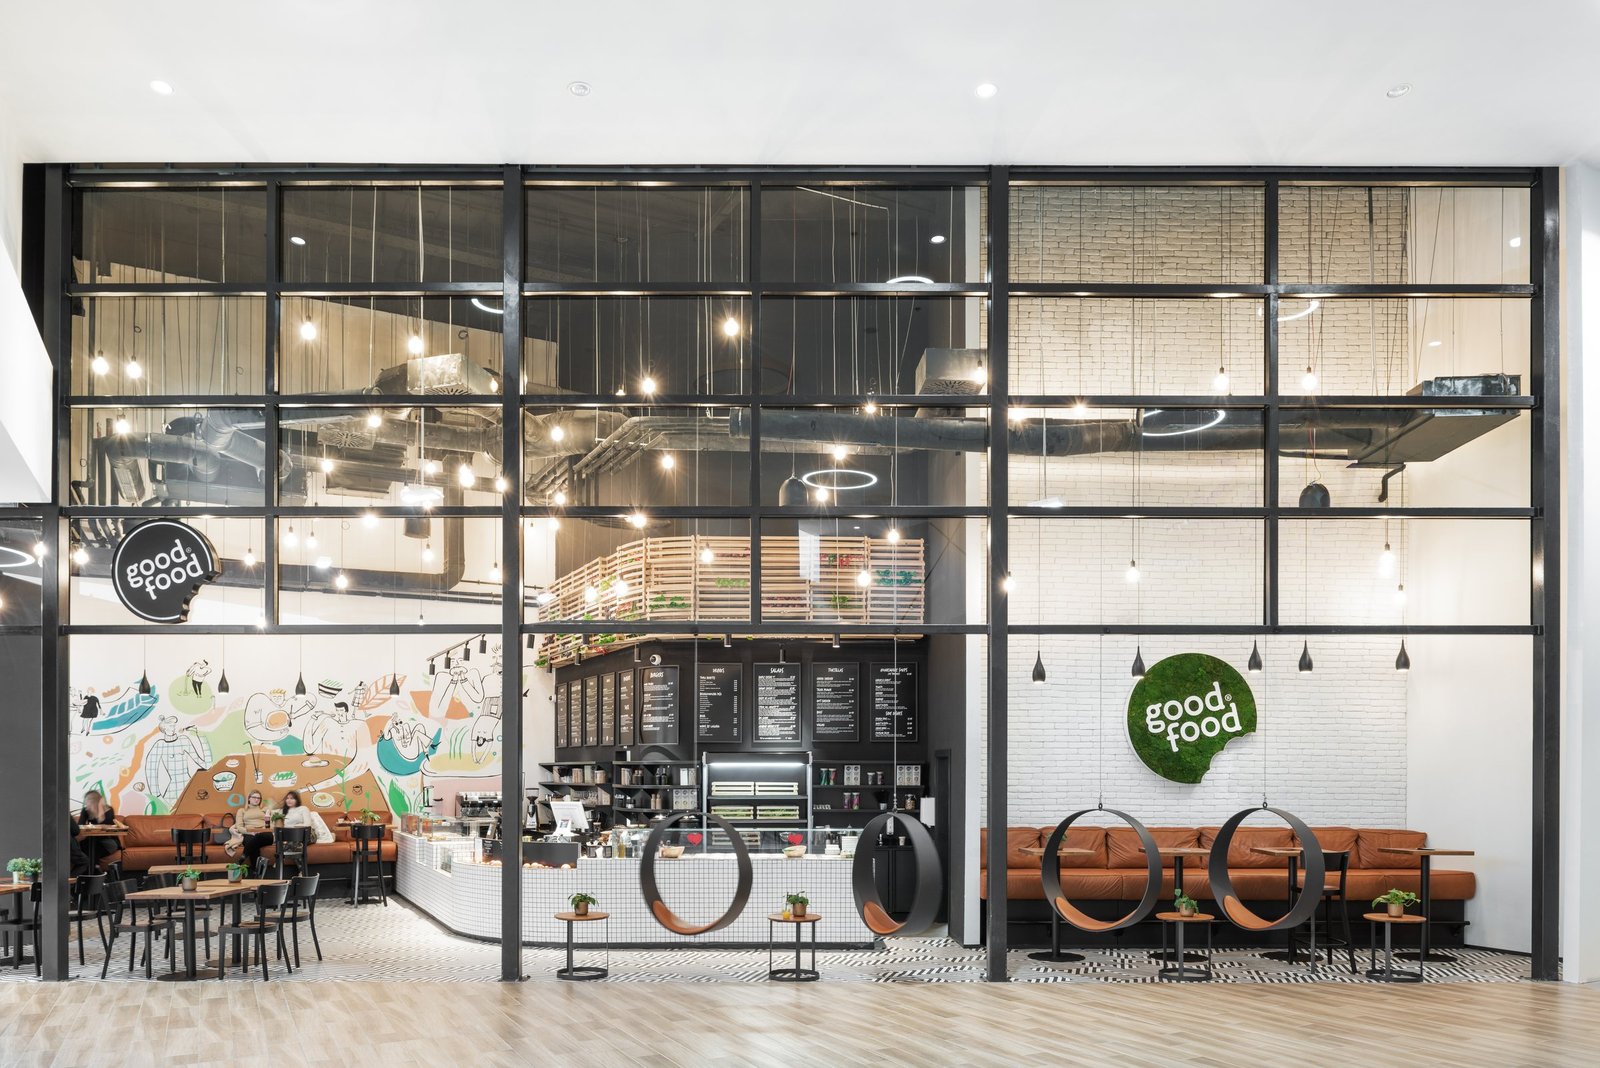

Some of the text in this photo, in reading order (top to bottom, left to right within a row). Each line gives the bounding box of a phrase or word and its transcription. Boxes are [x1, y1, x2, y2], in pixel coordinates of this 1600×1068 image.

[126, 539, 187, 588] good
[145, 553, 204, 600] food
[1146, 681, 1225, 733] good
[1167, 702, 1242, 752] food
